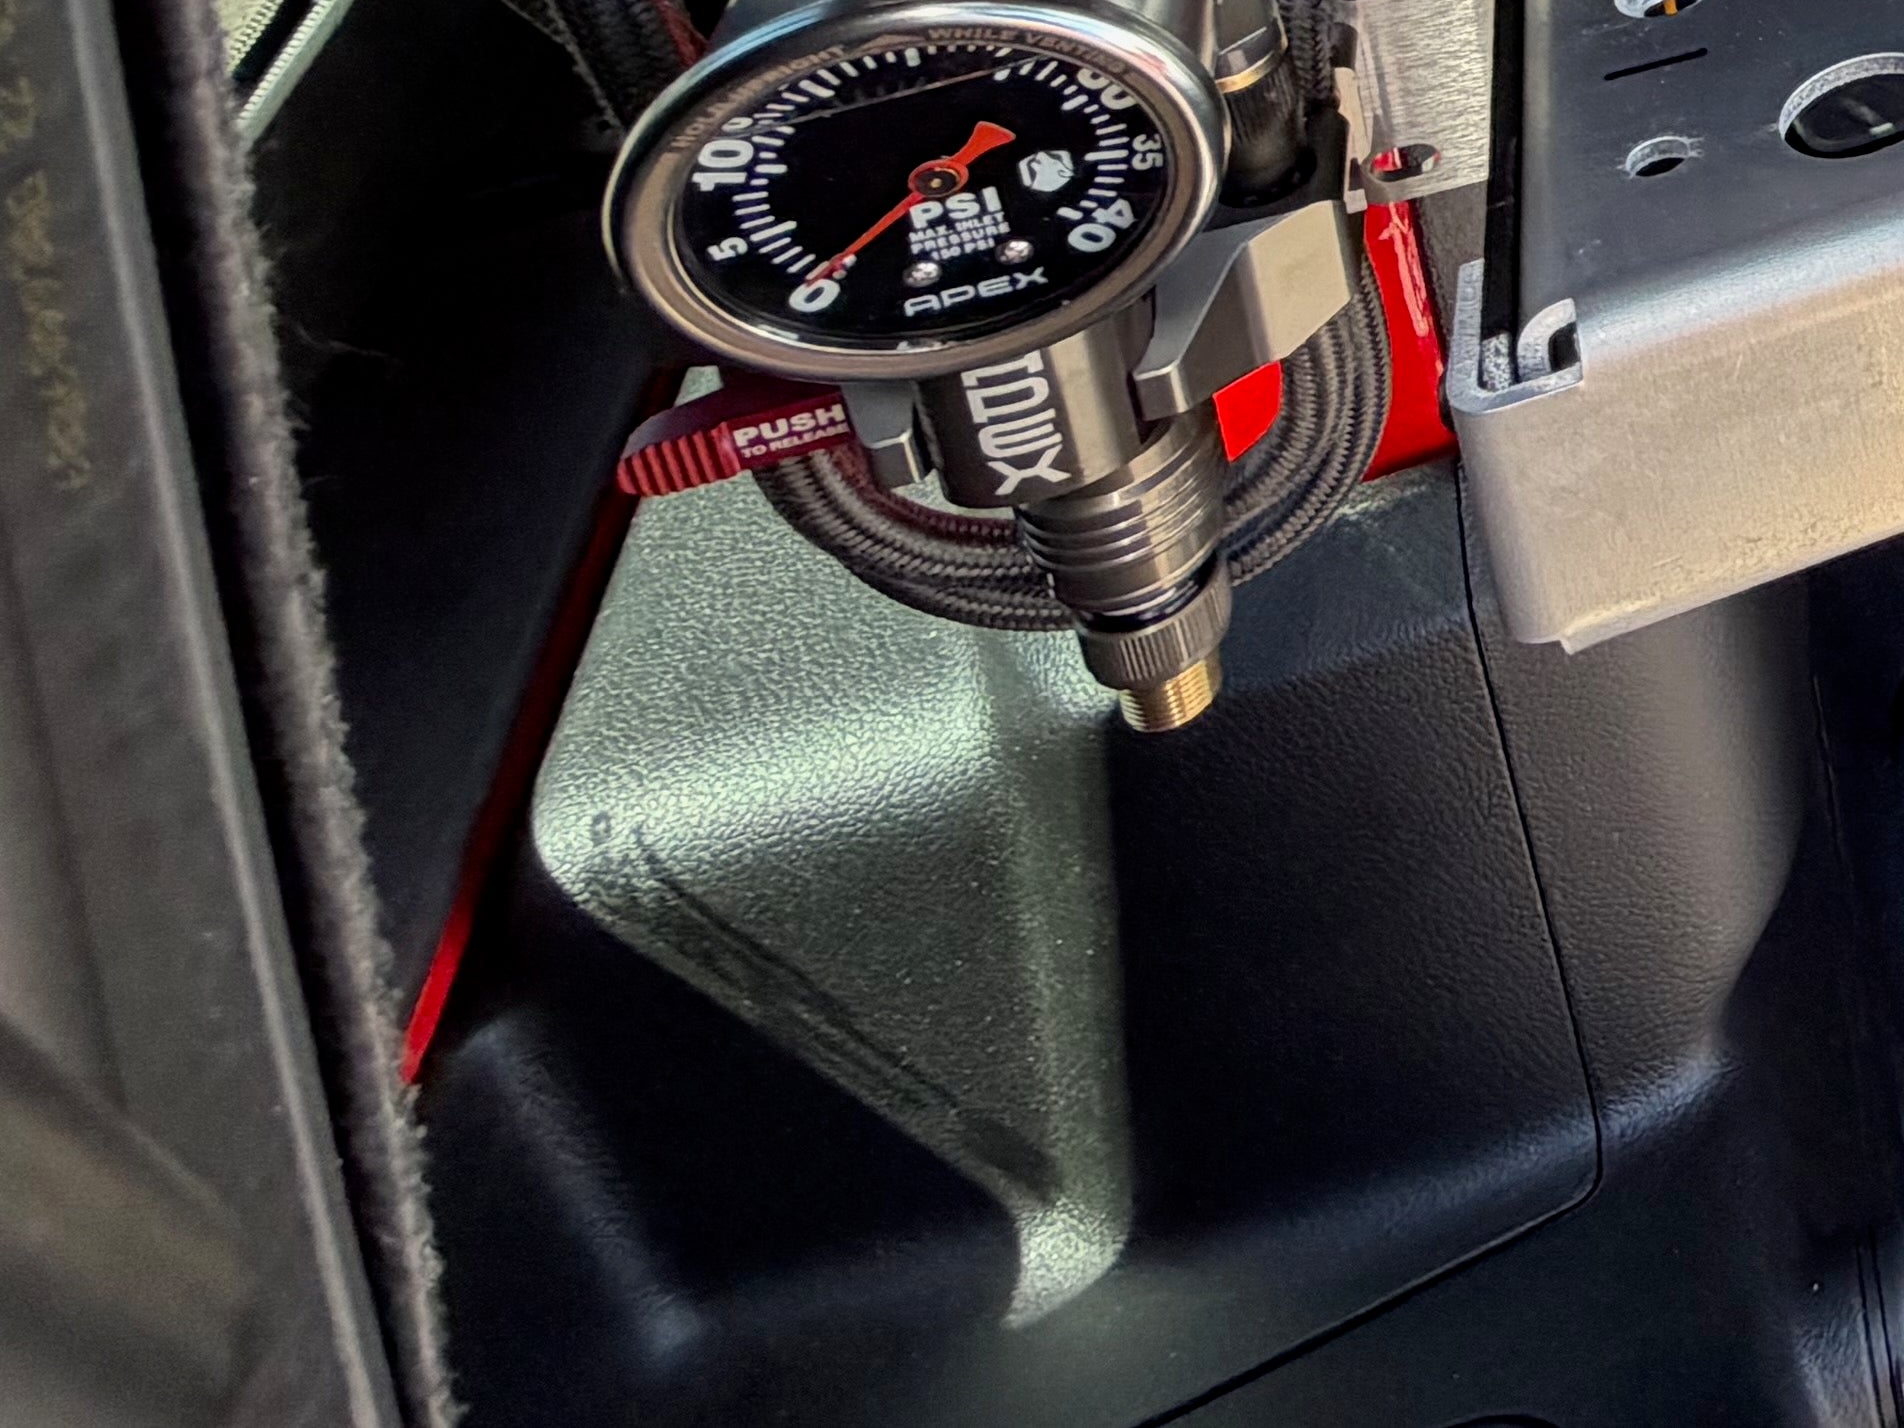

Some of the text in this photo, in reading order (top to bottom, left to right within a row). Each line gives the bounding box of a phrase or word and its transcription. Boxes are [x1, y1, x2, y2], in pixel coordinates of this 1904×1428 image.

[928, 26, 1019, 41] WHILE
[1025, 28, 1128, 75] VENTING
[692, 139, 754, 192] 10
[1131, 132, 1164, 171] 35
[909, 186, 1002, 229] PSI
[1067, 198, 1139, 253] 40
[706, 237, 748, 261] 5
[909, 225, 954, 243] MAX.
[910, 221, 1011, 255] PRESSURE
[931, 237, 995, 261] 150 PSI
[788, 279, 841, 313] 0
[903, 266, 1049, 317] APEX
[733, 403, 846, 447] PUSH
[740, 423, 850, 459] TO RELEASE
